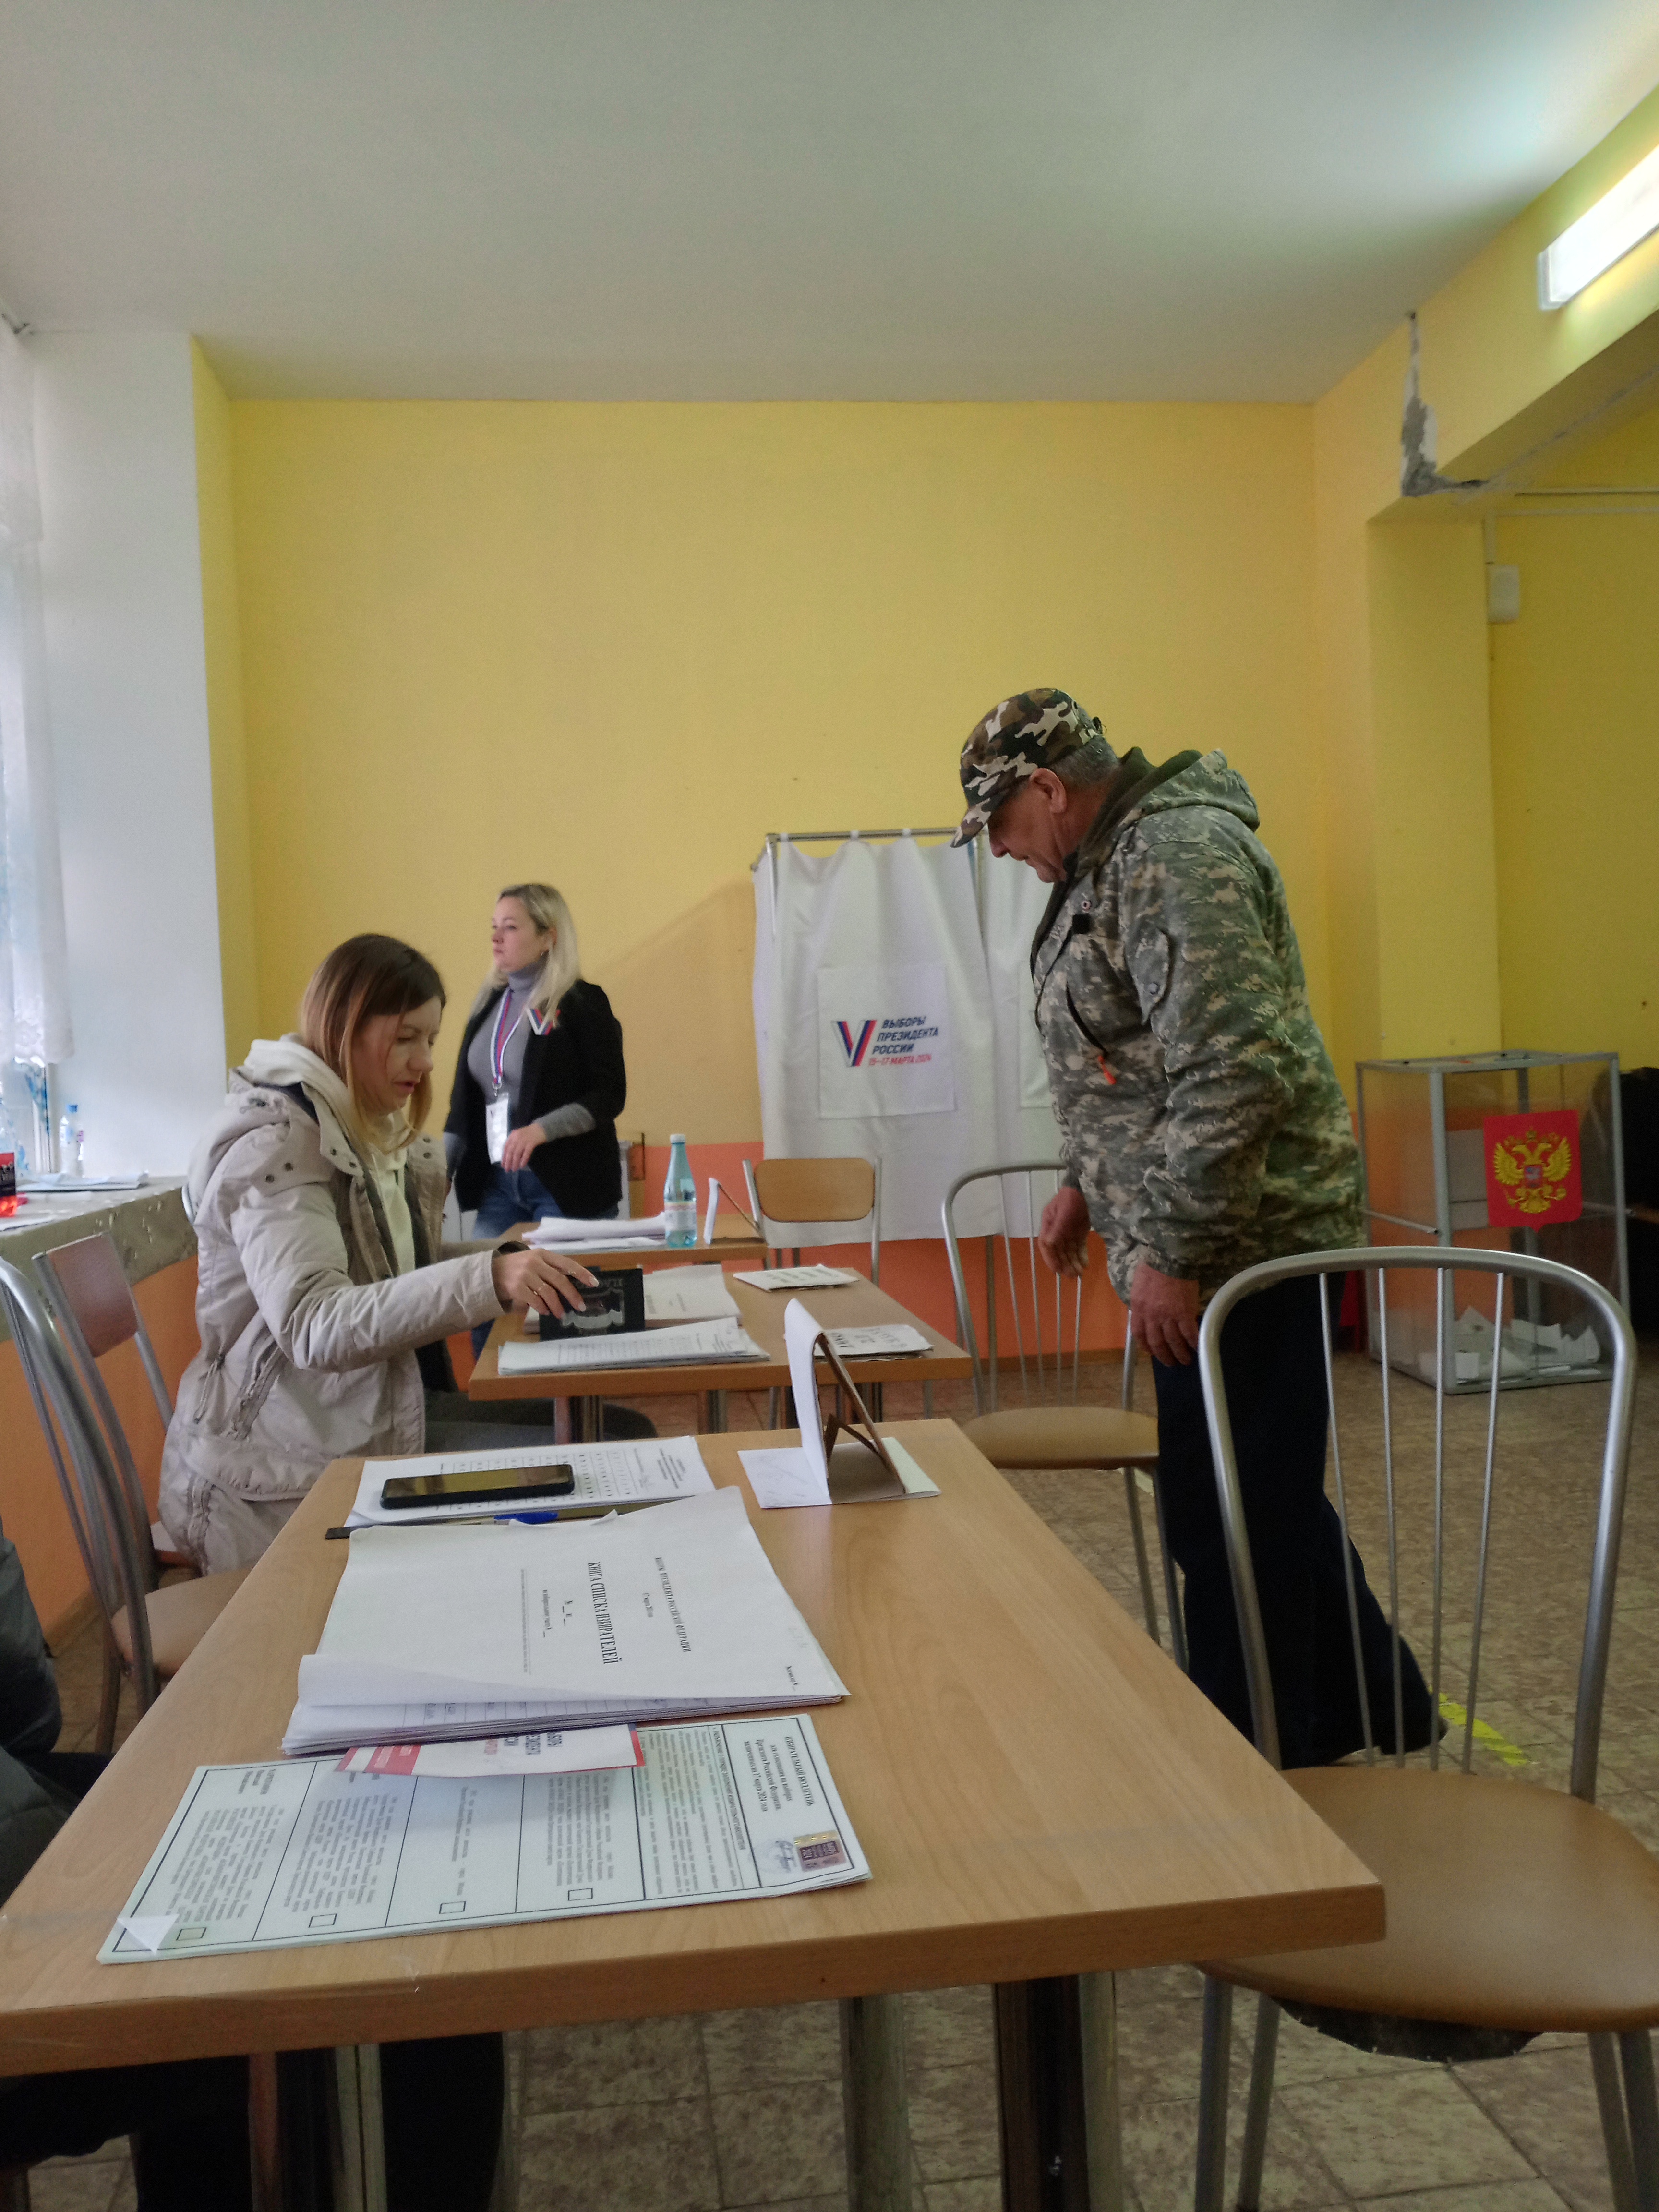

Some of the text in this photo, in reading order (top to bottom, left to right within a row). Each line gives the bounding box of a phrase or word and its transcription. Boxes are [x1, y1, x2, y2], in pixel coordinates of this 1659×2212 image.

[881, 1016, 926, 1029] ВЫБОРЫ
[877, 1027, 938, 1042] ПРЕЗИДЕНТА
[872, 1043, 914, 1055] РОССИИ
[588, 1562, 622, 1664] КНИГА СПИСКА ИЗБИРАТЕЛЕЙ
[785, 1737, 815, 1806] ИЗБИРАТЕЛЬНЫЙ БЮЛЛЕТЕНЬ
